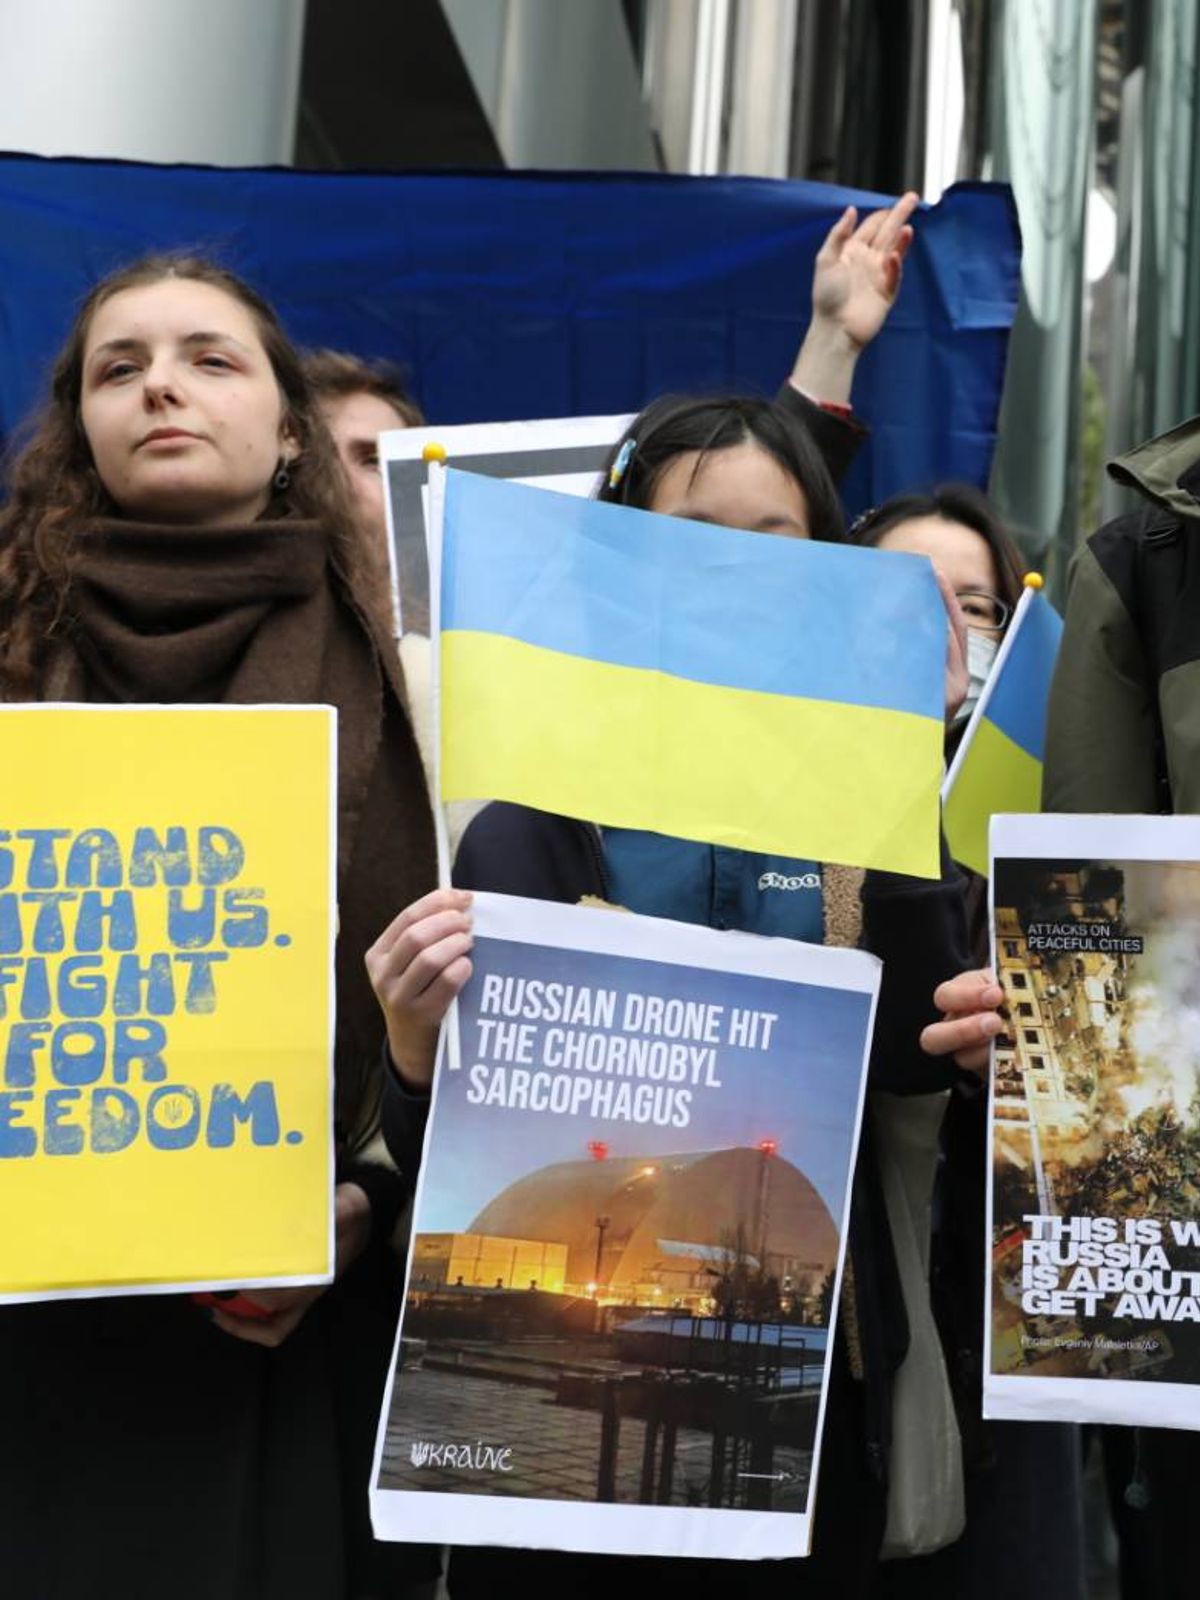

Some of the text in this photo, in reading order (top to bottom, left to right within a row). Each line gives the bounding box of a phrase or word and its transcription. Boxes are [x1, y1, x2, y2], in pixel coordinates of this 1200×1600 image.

[168, 888, 291, 948] US.
[1028, 924, 1110, 937] ATTACKS ON
[1029, 937, 1140, 951] PEACEFUL CITIES
[480, 975, 778, 1050] RUSSIAN DRONE HIT
[5, 1019, 167, 1088] FOR
[477, 1019, 721, 1088] THE CHORNOBYL
[466, 1065, 692, 1128] SARCOPHAGUS
[1022, 1215, 1117, 1243] THIS
[1125, 1219, 1162, 1245] IS
[1023, 1240, 1171, 1270] RUSSIA
[1022, 1265, 1058, 1290] IS
[1021, 1290, 1105, 1317] GET
